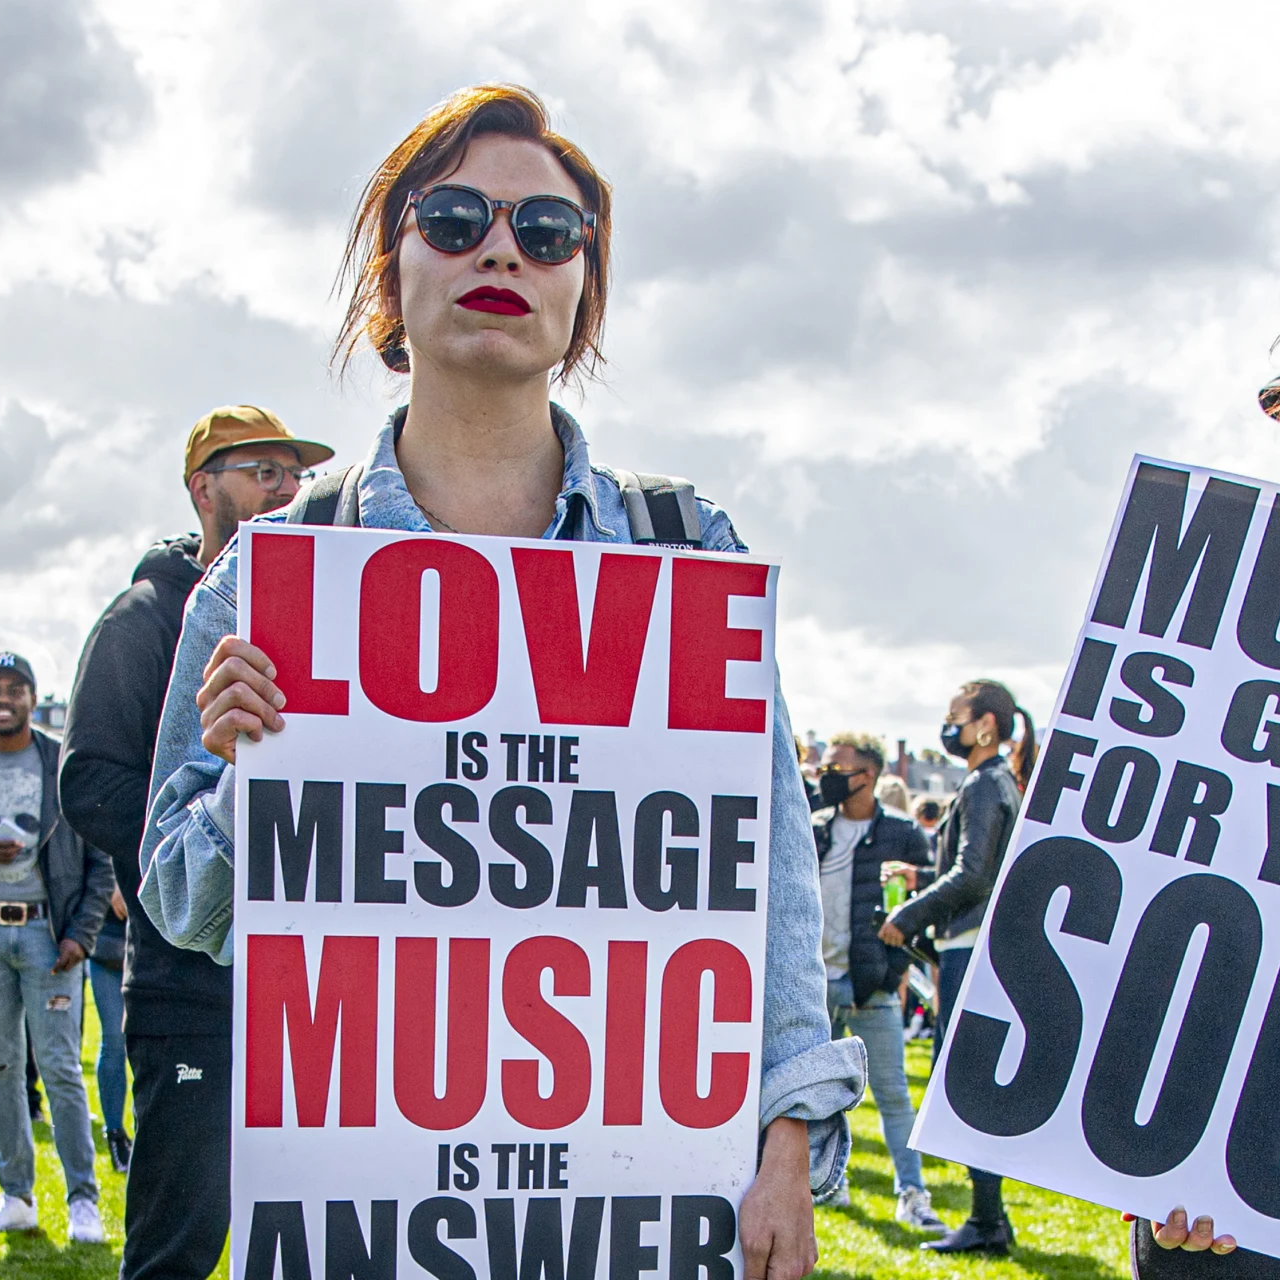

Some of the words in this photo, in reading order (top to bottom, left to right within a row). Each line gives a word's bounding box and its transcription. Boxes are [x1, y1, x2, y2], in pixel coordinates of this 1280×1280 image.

[250, 532, 770, 733] LOVE
[1060, 637, 1194, 738] IS
[445, 731, 488, 781] IS
[500, 733, 579, 783] THE
[1025, 729, 1233, 866] FOR
[247, 778, 758, 912] MESSAGE
[245, 934, 752, 1130] MUSIC
[437, 1143, 480, 1191] IS
[490, 1143, 569, 1190] THE
